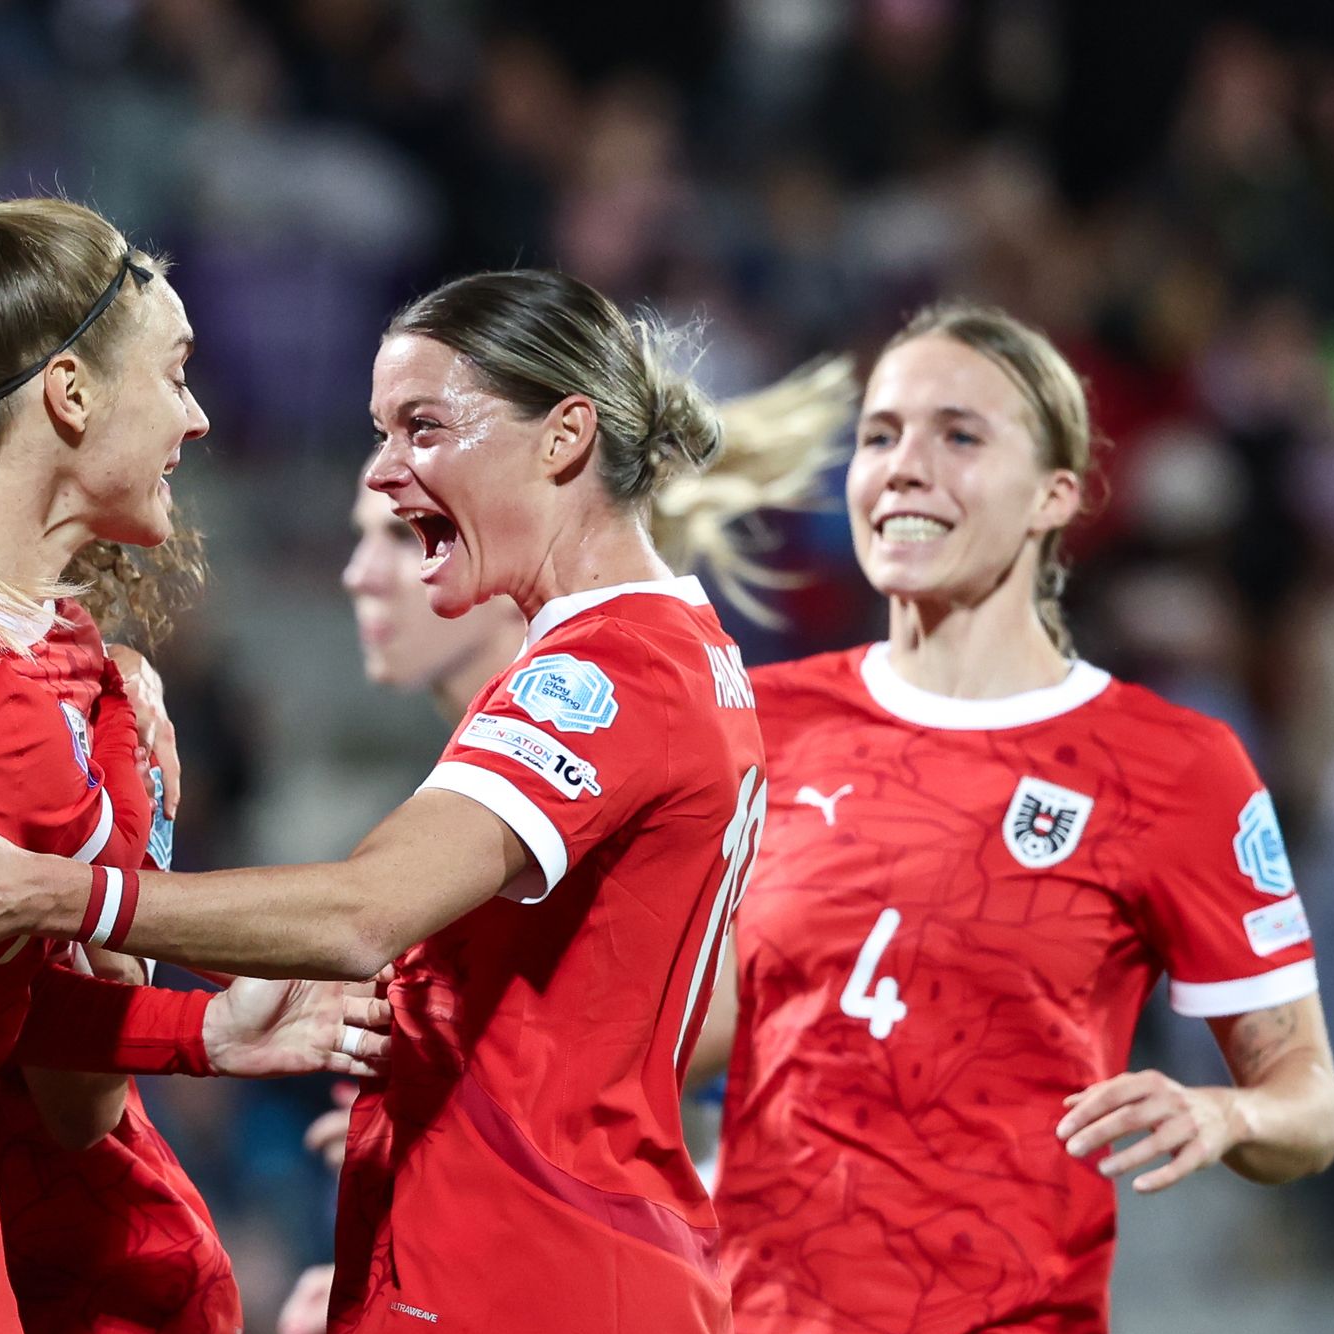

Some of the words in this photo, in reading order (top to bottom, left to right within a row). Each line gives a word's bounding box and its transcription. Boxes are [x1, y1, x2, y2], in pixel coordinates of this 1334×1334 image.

[544, 680, 571, 696] play
[549, 673, 566, 684] We
[541, 687, 581, 711] Strong
[469, 725, 553, 762] FOUNDATION
[554, 754, 583, 786] 10
[839, 907, 907, 1041] 4
[390, 1301, 439, 1323] ULTRAWEAVE
